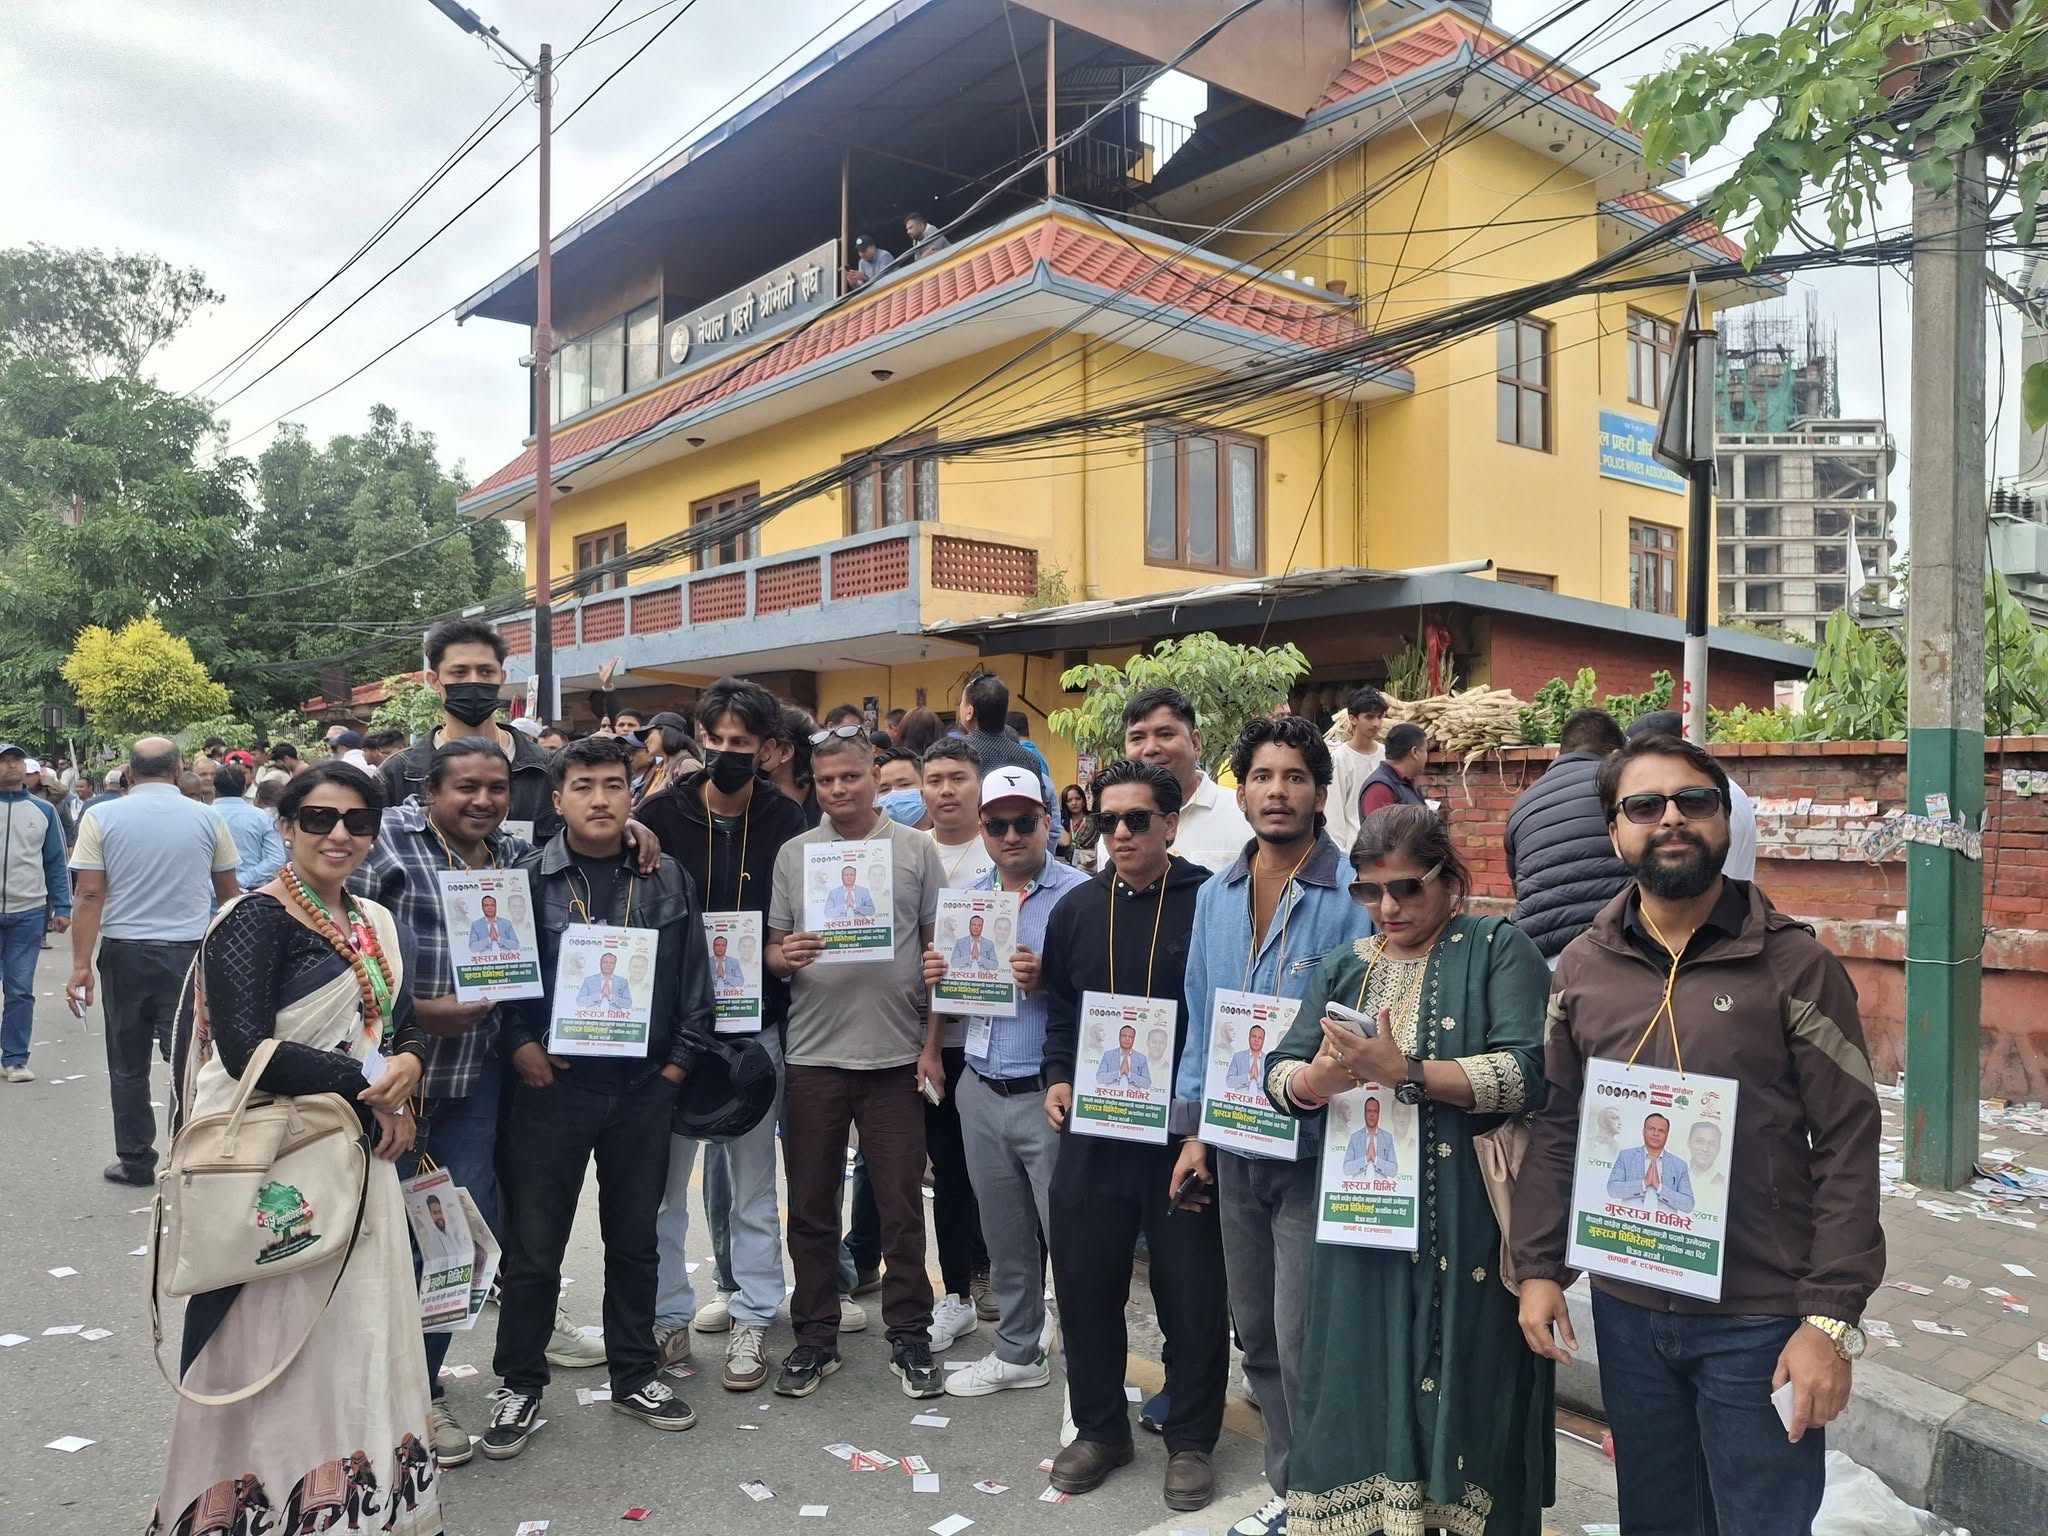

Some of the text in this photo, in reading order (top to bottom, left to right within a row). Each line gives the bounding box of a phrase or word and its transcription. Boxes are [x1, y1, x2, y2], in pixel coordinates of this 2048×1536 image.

[698, 313, 726, 344] नेपाल
[731, 291, 756, 336] प्रहरी
[760, 271, 796, 318] श्रीमती
[1612, 434, 1635, 453] प्रहरी
[1603, 454, 1625, 470] POLICE
[1626, 460, 1645, 475] WIVES
[1589, 1158, 1613, 1169] VOTE
[1604, 1203, 1694, 1231] गुरुराज घिमिरे
[1693, 1210, 1719, 1223] VOTE
[1588, 1225, 1617, 1240] गुरुराज
